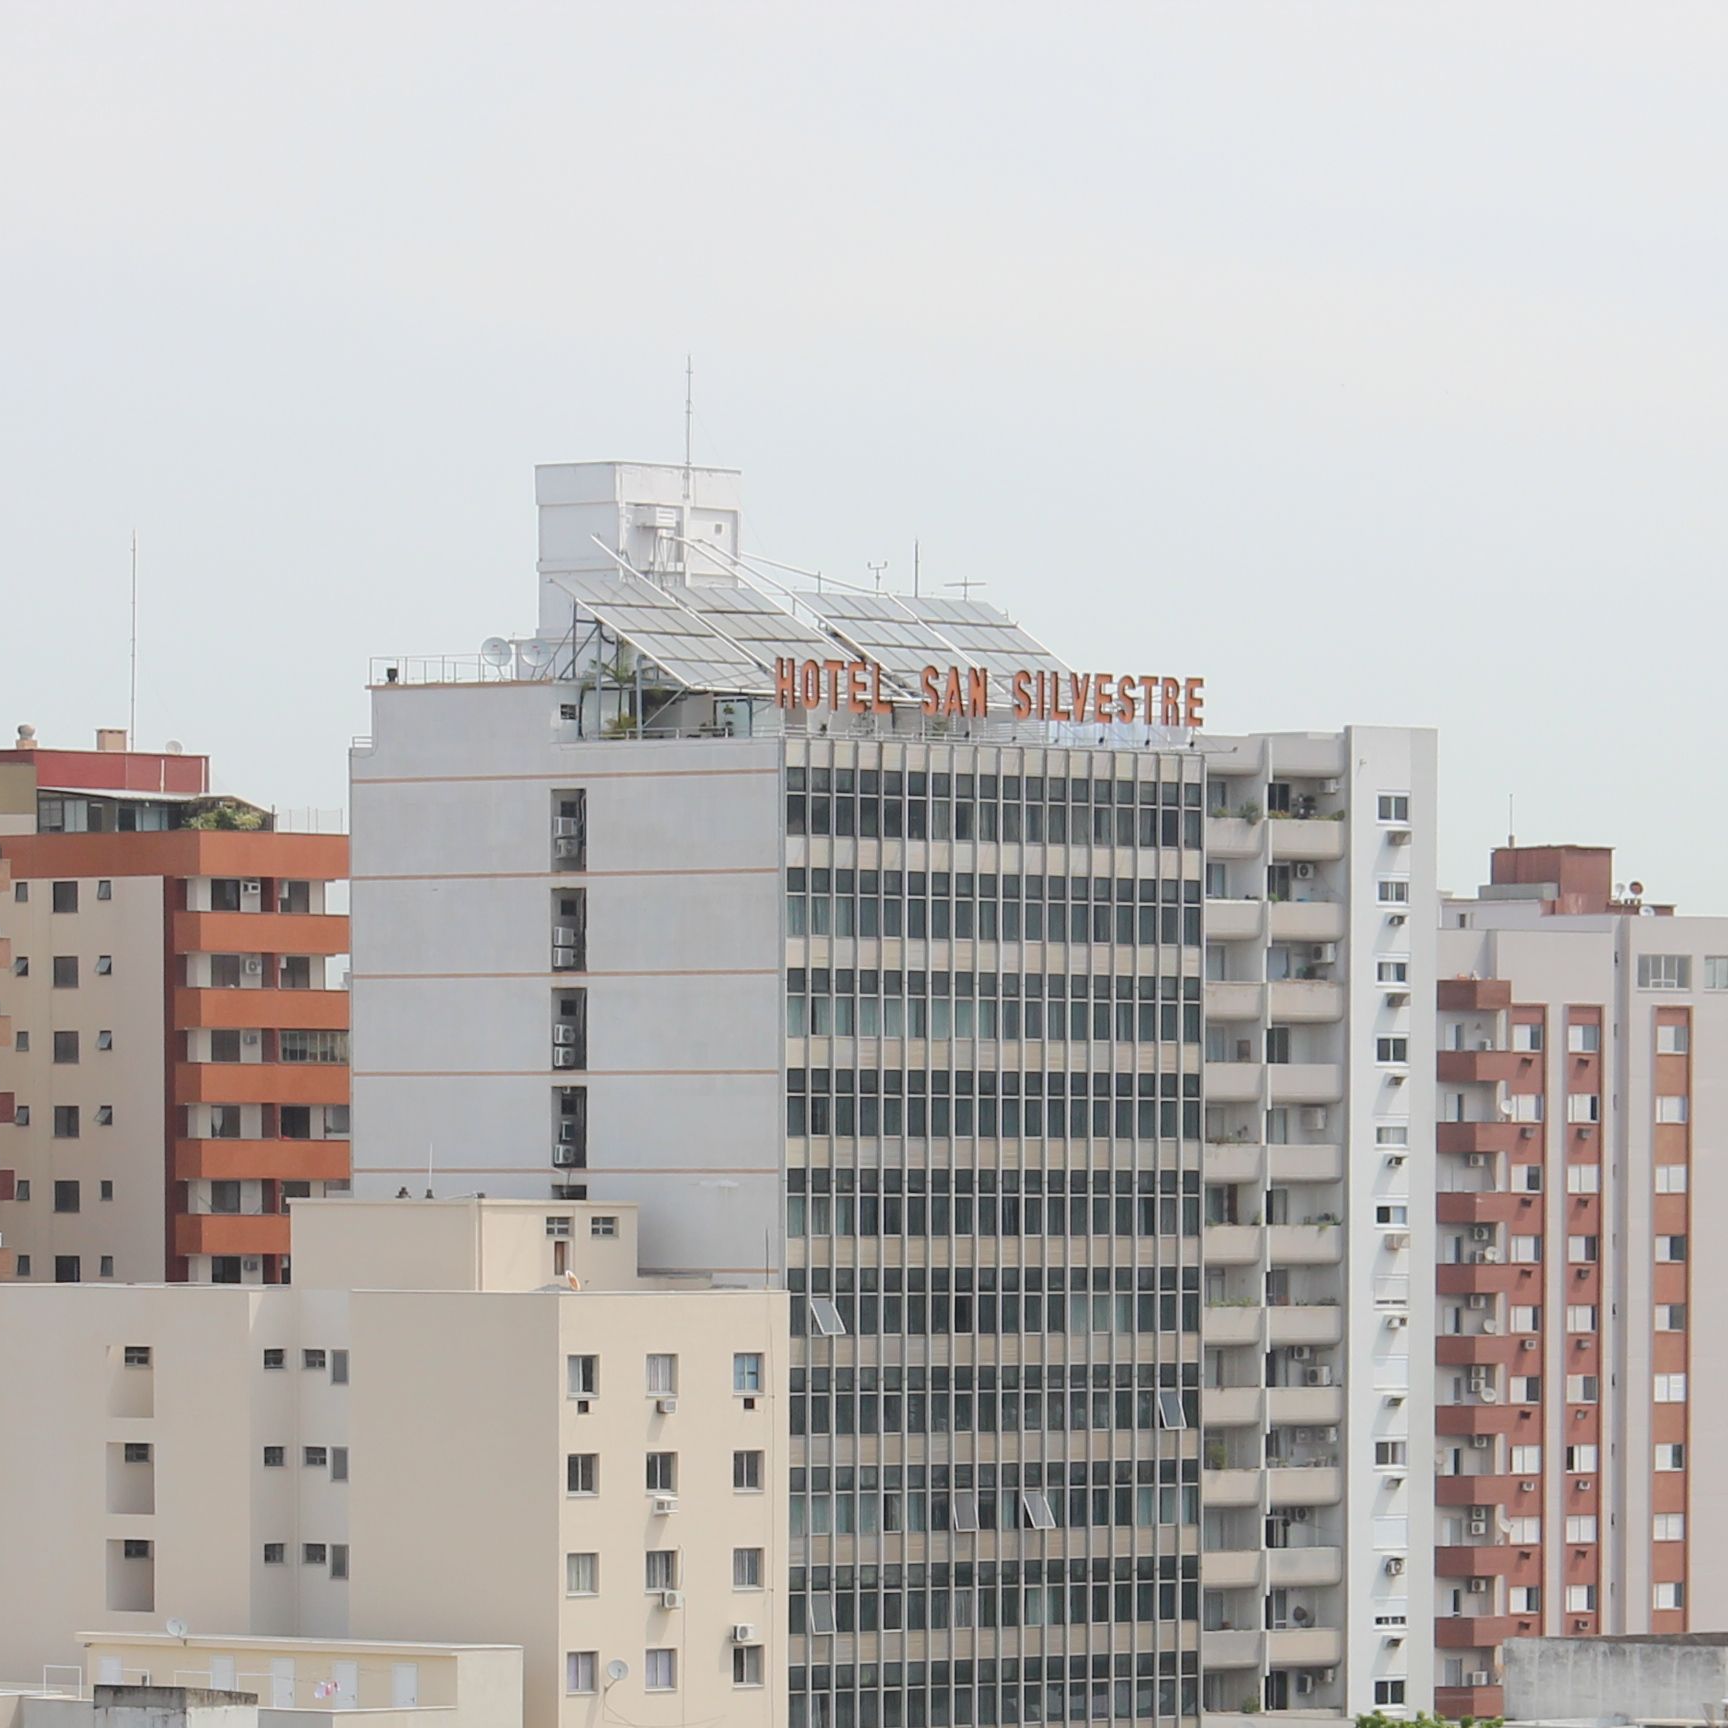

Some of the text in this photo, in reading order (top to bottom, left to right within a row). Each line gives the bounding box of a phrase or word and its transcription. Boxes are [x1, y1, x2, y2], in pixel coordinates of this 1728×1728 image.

[773, 656, 1205, 727] HOTEL SAN SILVESTRE
